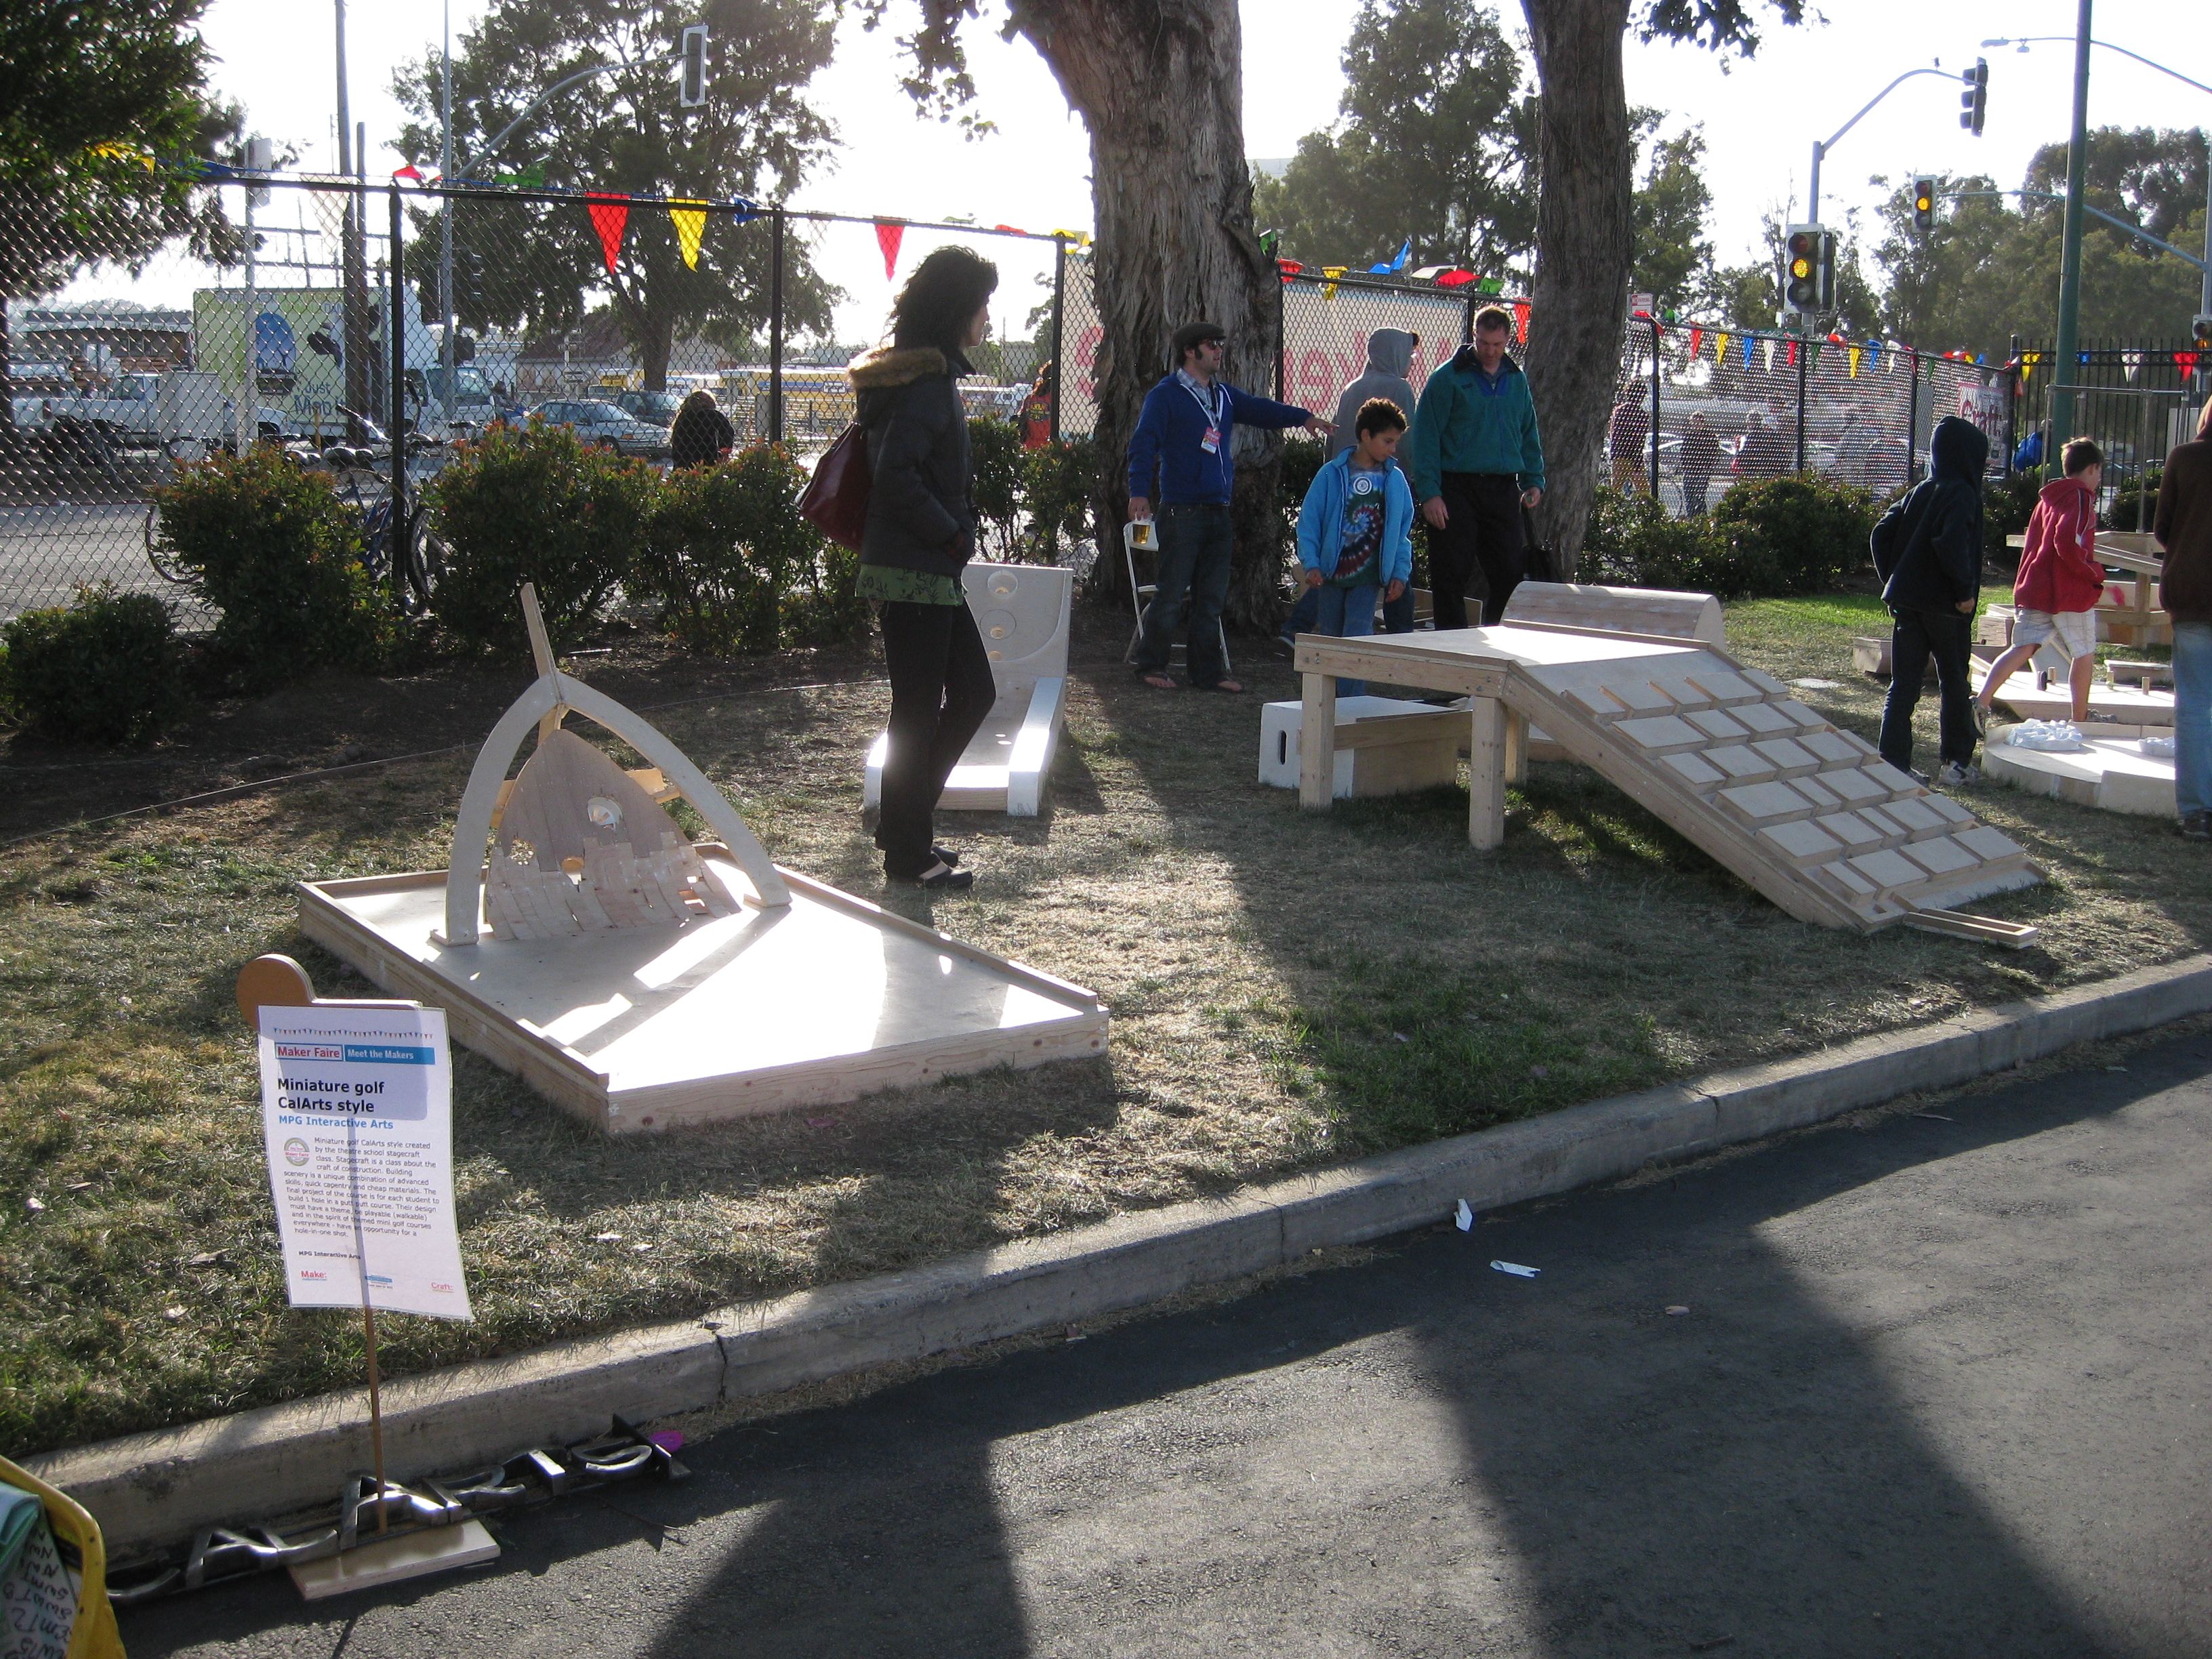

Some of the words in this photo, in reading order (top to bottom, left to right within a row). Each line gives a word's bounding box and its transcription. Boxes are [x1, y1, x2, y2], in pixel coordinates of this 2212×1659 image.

[278, 1046, 311, 1057] Maker
[314, 1048, 340, 1057] Faire
[348, 1049, 367, 1057] Meet
[385, 1050, 413, 1059] Makers
[278, 1078, 350, 1092] Miniature
[355, 1082, 385, 1096] golf
[278, 1097, 332, 1110] CalArts
[337, 1099, 374, 1114] style
[279, 1115, 302, 1125] MPG
[306, 1117, 367, 1128] Interactive
[370, 1120, 394, 1129] Arts
[347, 1139, 359, 1147] golf
[336, 1156, 369, 1164] Stagecraft
[342, 1166, 384, 1174] construction.
[386, 1168, 412, 1176] Building
[393, 1213, 427, 1221] (walkable)
[293, 1220, 330, 1228] everywhere
[363, 1227, 400, 1235] opportunity
[301, 1270, 327, 1278] Make:
[431, 1282, 454, 1290] Craft:
